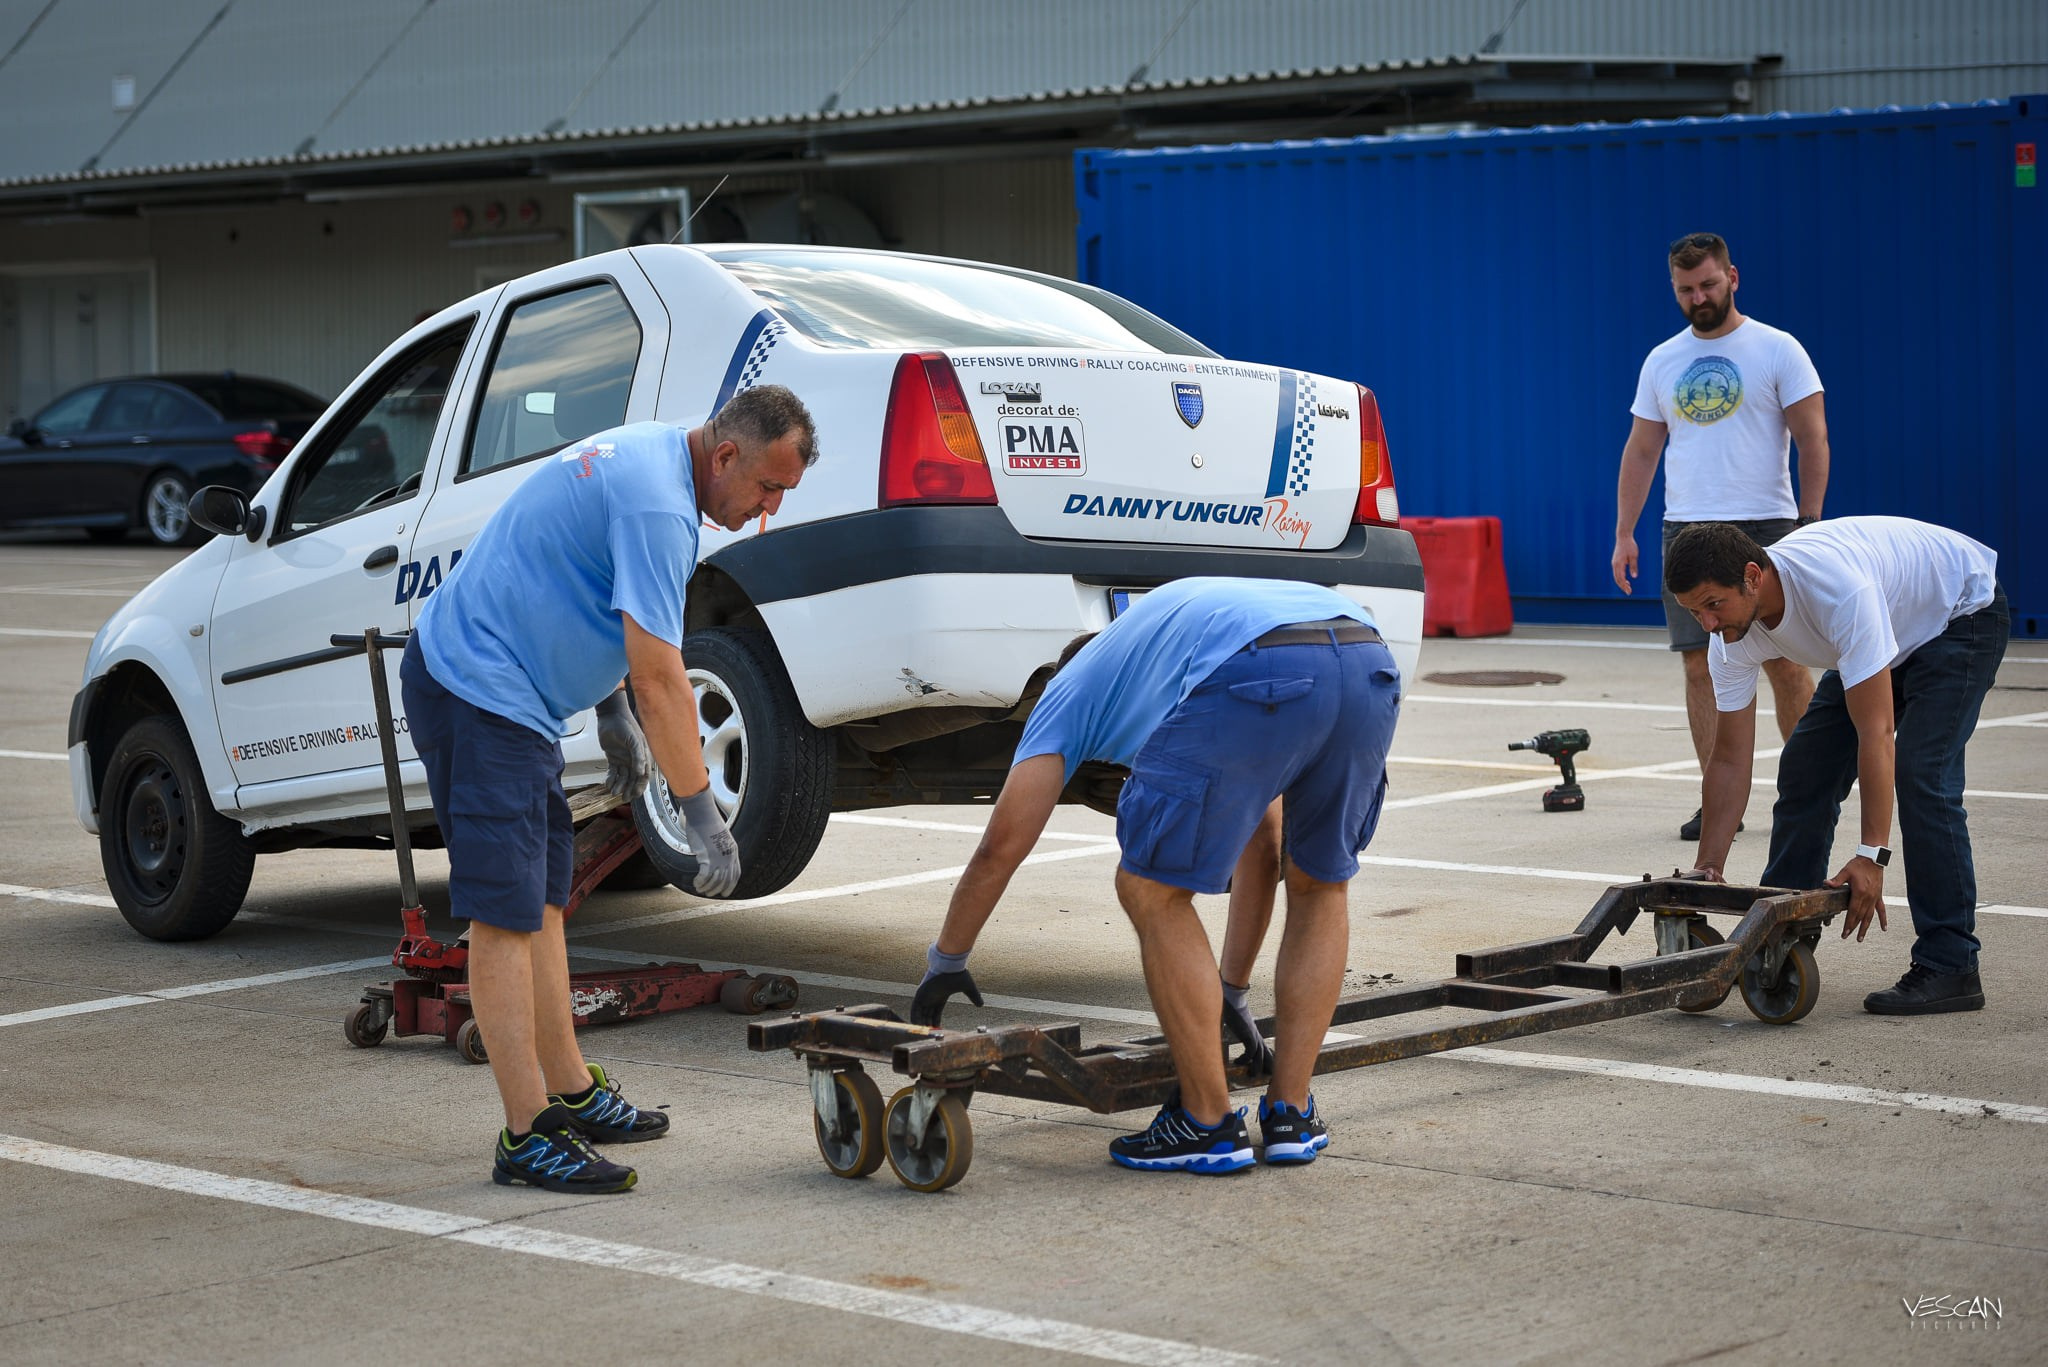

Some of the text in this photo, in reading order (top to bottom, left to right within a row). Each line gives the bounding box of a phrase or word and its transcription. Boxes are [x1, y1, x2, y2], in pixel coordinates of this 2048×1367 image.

[952, 356, 1025, 368] DEFENSIVE
[980, 381, 1042, 395] LOGAN
[1177, 387, 1201, 395] DACIA
[997, 403, 1080, 416] decorat de:
[1690, 405, 1729, 420] FRANCE
[1005, 425, 1080, 453] PMA
[1012, 458, 1079, 468] INVEST
[1263, 498, 1312, 550] Racing
[232, 736, 298, 762] #DEFENSIVE
